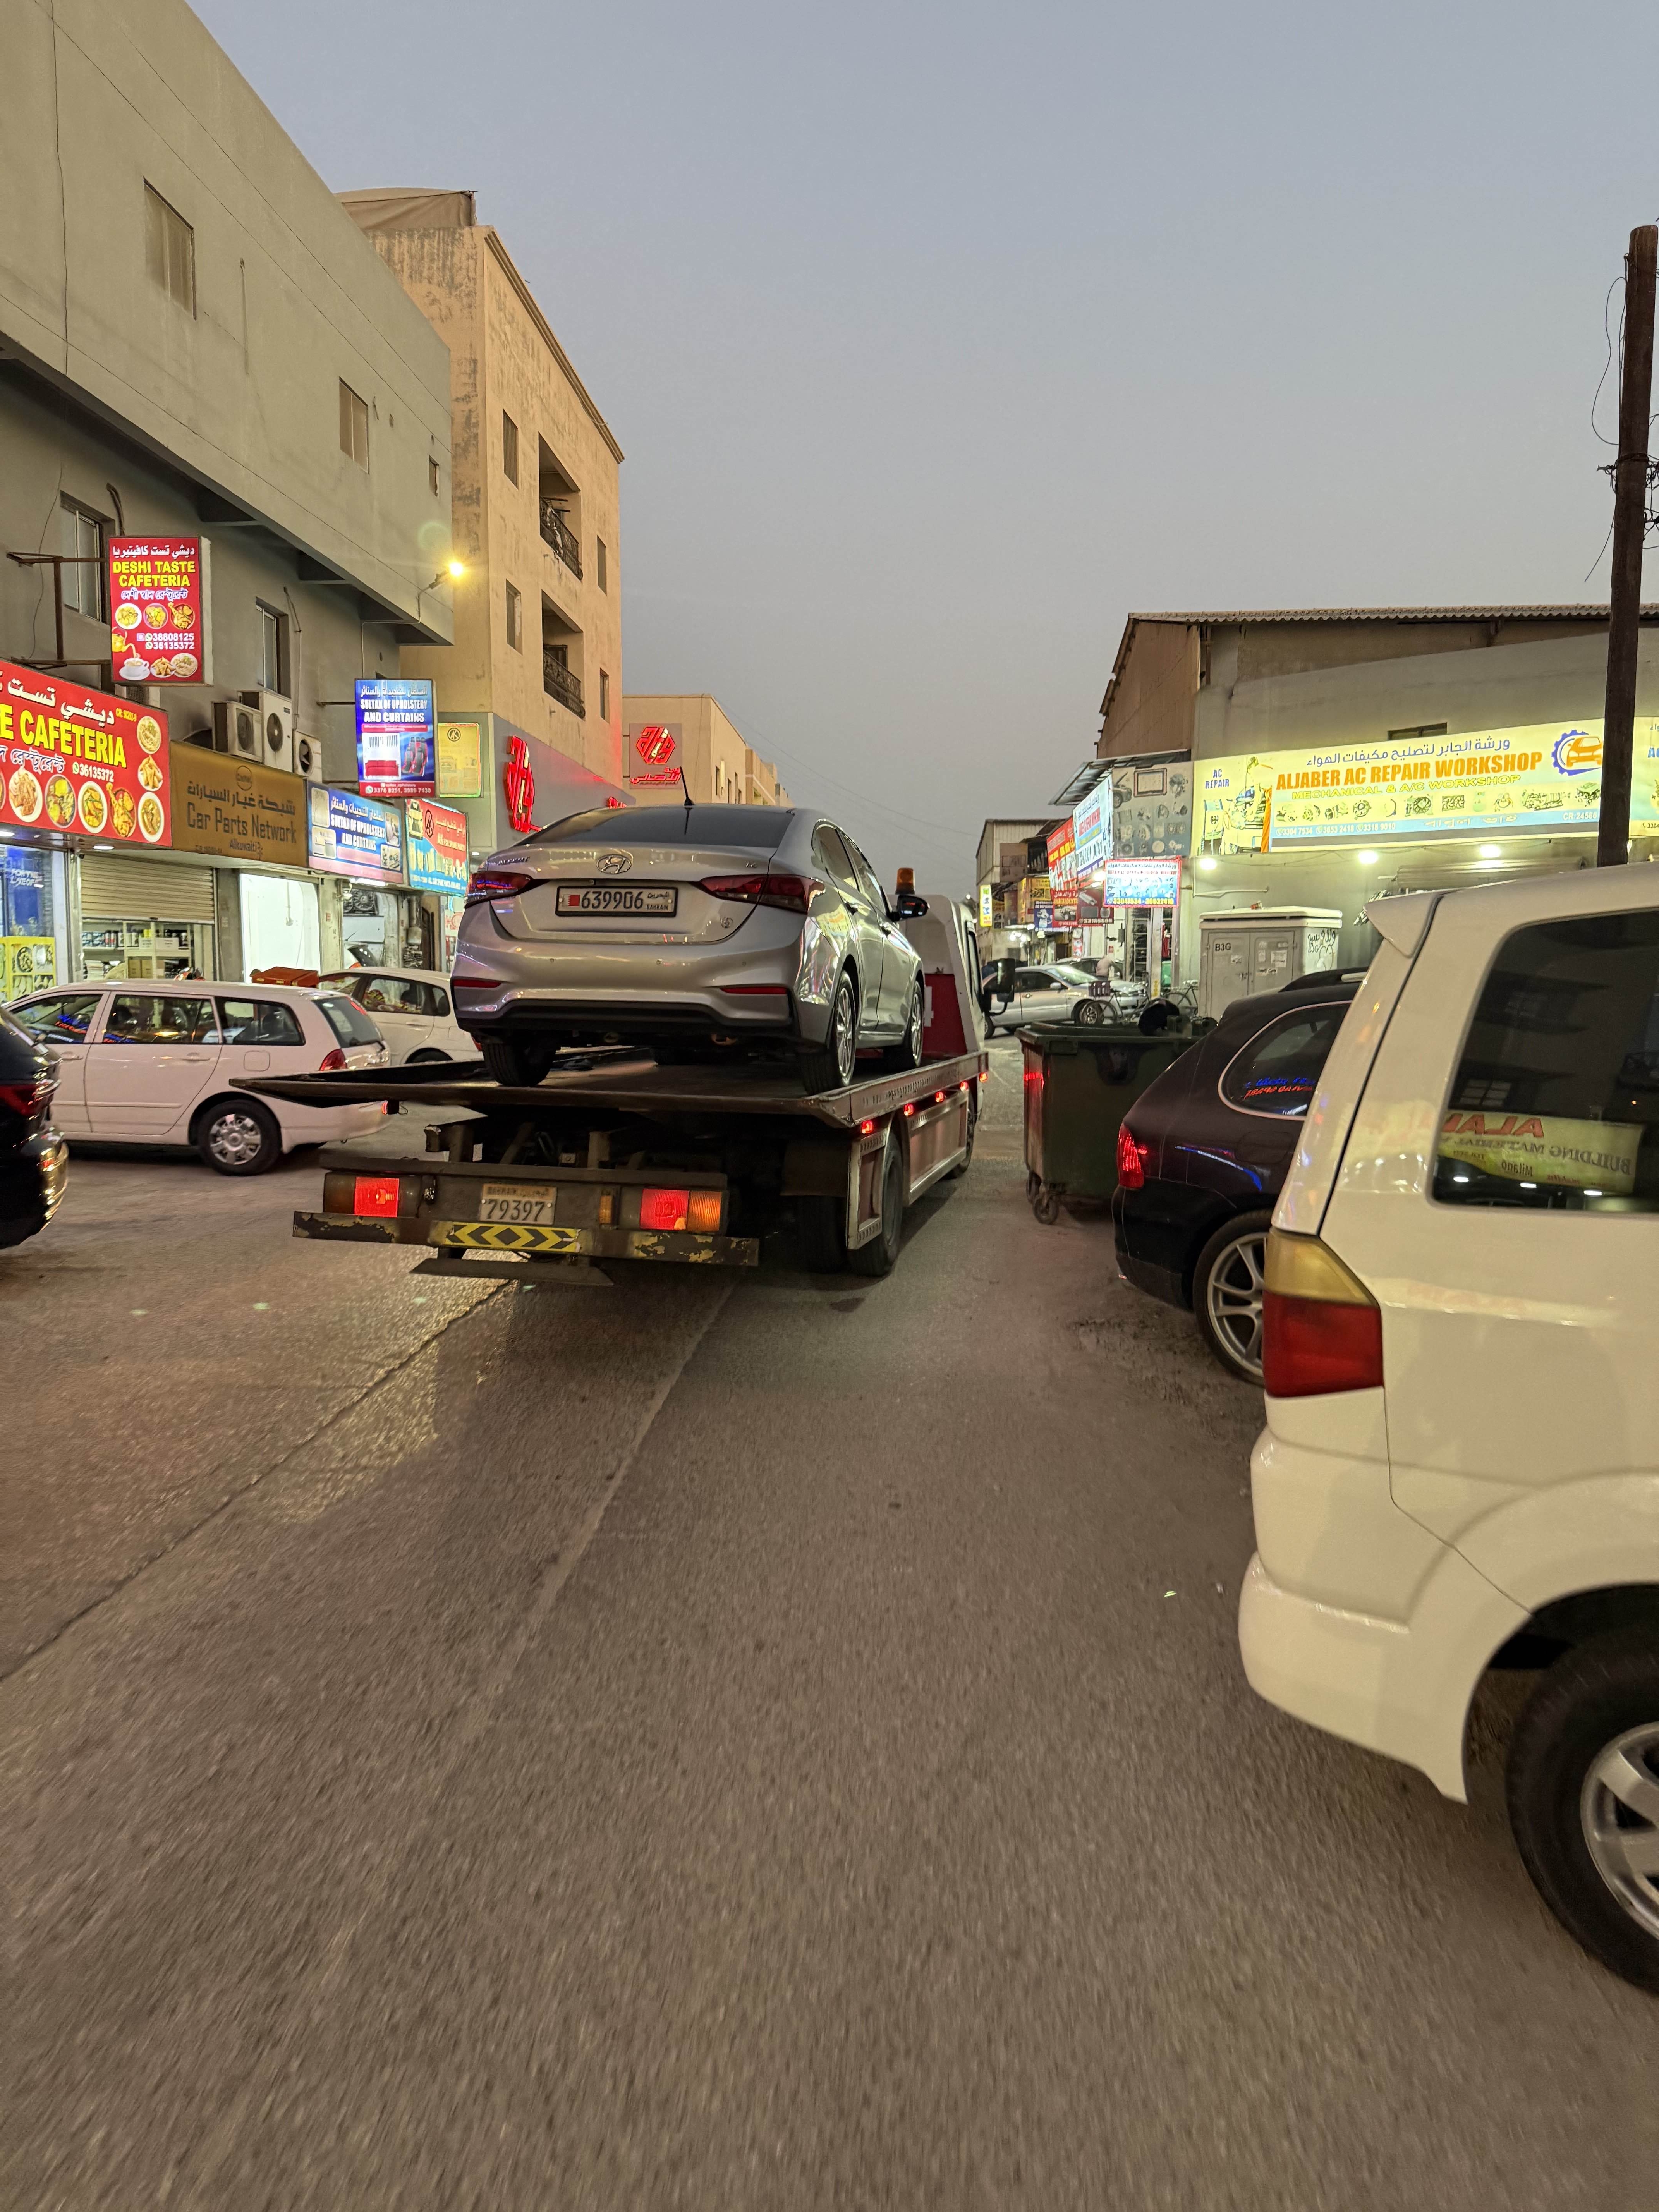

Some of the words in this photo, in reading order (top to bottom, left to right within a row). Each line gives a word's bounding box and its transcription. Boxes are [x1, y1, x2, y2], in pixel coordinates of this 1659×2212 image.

[113, 545, 149, 558] كافيتيريا
[151, 545, 170, 555] تست
[172, 544, 195, 559] ديشي
[113, 561, 151, 573] DESHI
[155, 561, 196, 573] TASTE
[119, 575, 190, 587] CAFETERIA
[153, 633, 194, 641] 38808125
[153, 641, 195, 650] 36135372
[8, 678, 56, 707] تست
[361, 699, 383, 709] SULTAN
[383, 699, 391, 709] OF
[392, 699, 427, 709] UPHOLSTERY
[61, 699, 115, 727] ديشي
[364, 712, 381, 722] AND
[383, 712, 425, 723] CURTAINS
[20, 710, 127, 768] CAFETERIA
[1475, 735, 1511, 750] ورشة
[1391, 744, 1435, 761] لتصليح
[1436, 740, 1472, 757] الجابر
[1307, 753, 1340, 767] الهواء
[1342, 749, 1388, 765] مكيفات
[79, 763, 114, 782] 36135372
[1213, 769, 1223, 778] AC
[1276, 768, 1340, 791] ALJABER
[1344, 767, 1366, 786] AC
[1370, 761, 1431, 783] REPAIR
[1435, 752, 1542, 778] WORKSHOP
[1205, 779, 1230, 789] REPAIR
[1292, 786, 1385, 800] MECHANICAL
[1400, 781, 1425, 792] A/C
[1428, 775, 1522, 790] WORKSHOP
[187, 802, 210, 830] Car
[215, 807, 247, 836] Parts
[252, 814, 296, 843] Network
[331, 814, 350, 830] SULTAN
[350, 819, 357, 831] OF
[357, 820, 385, 838] UPHOLSTERY
[581, 891, 643, 909] 639906
[487, 1199, 545, 1222] 79397
